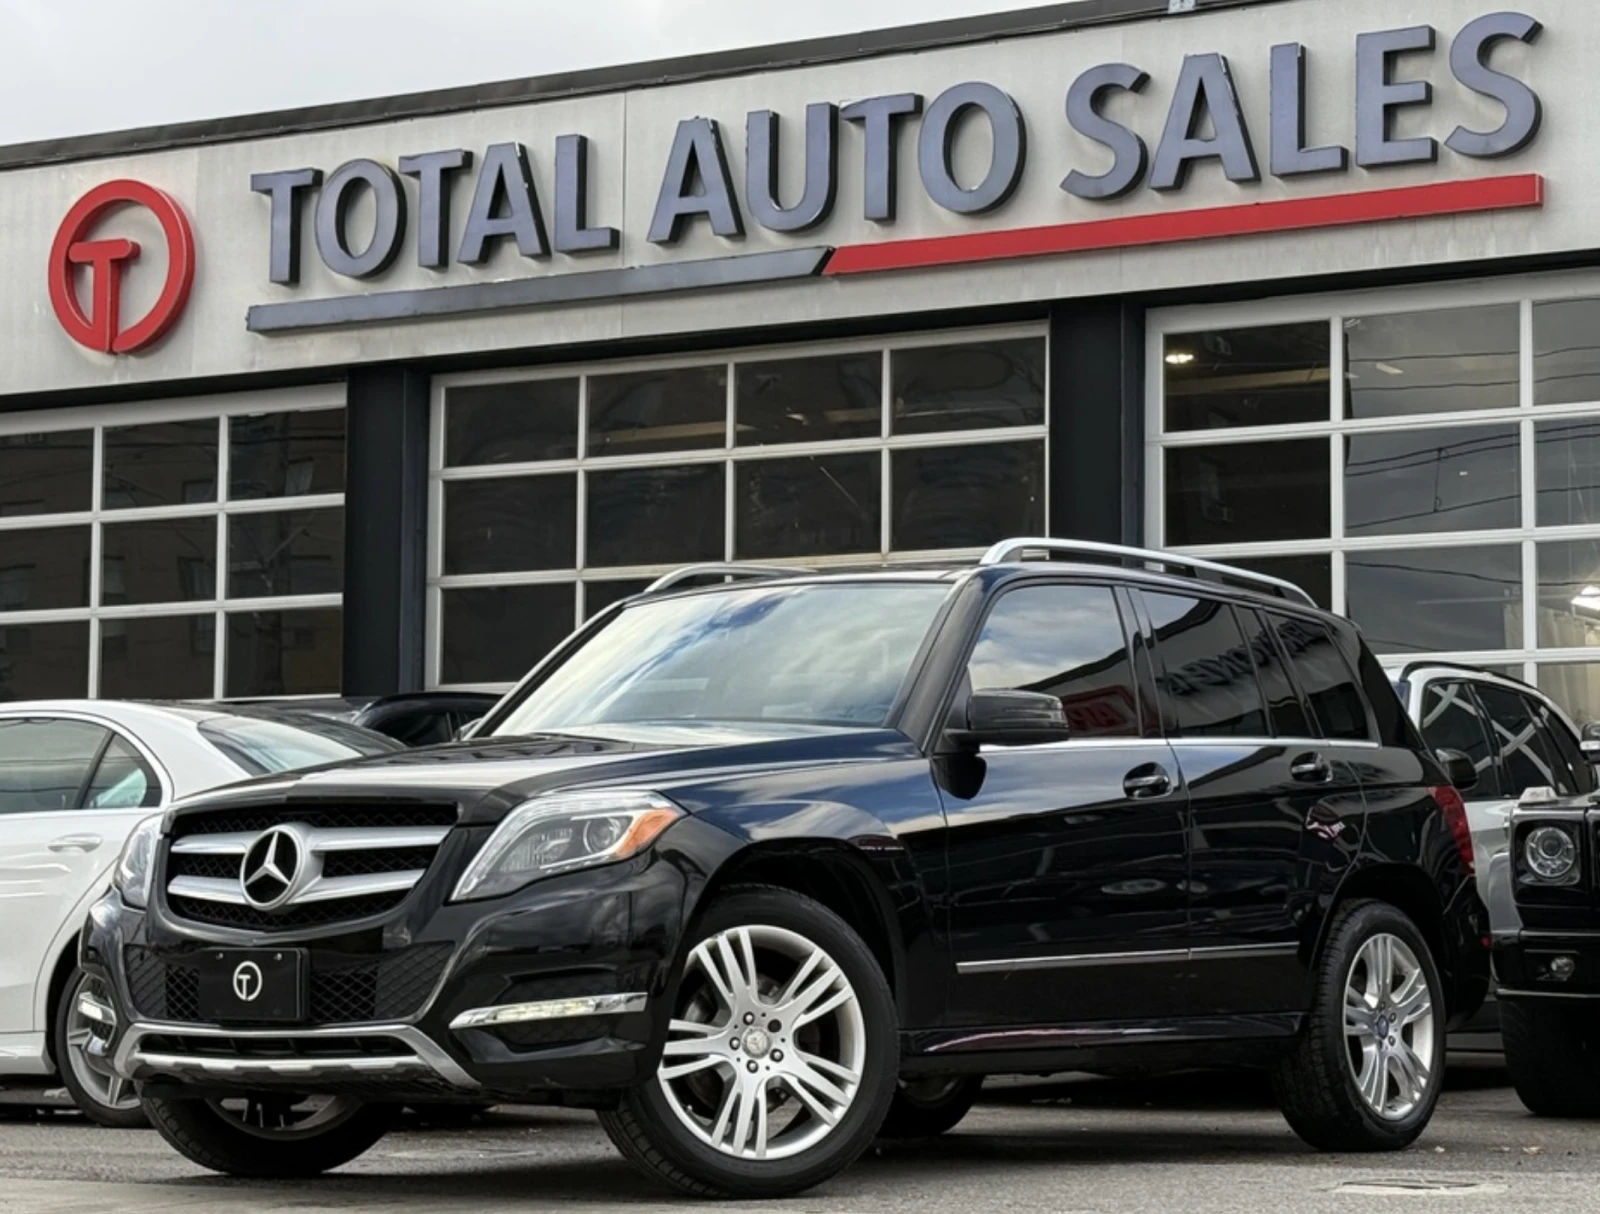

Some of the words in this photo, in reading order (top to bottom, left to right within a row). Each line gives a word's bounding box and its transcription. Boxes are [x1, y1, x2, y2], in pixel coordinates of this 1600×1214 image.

[250, 133, 620, 285] TOTAL
[646, 80, 1027, 245] AUTO
[1059, 11, 1544, 201] SALES
